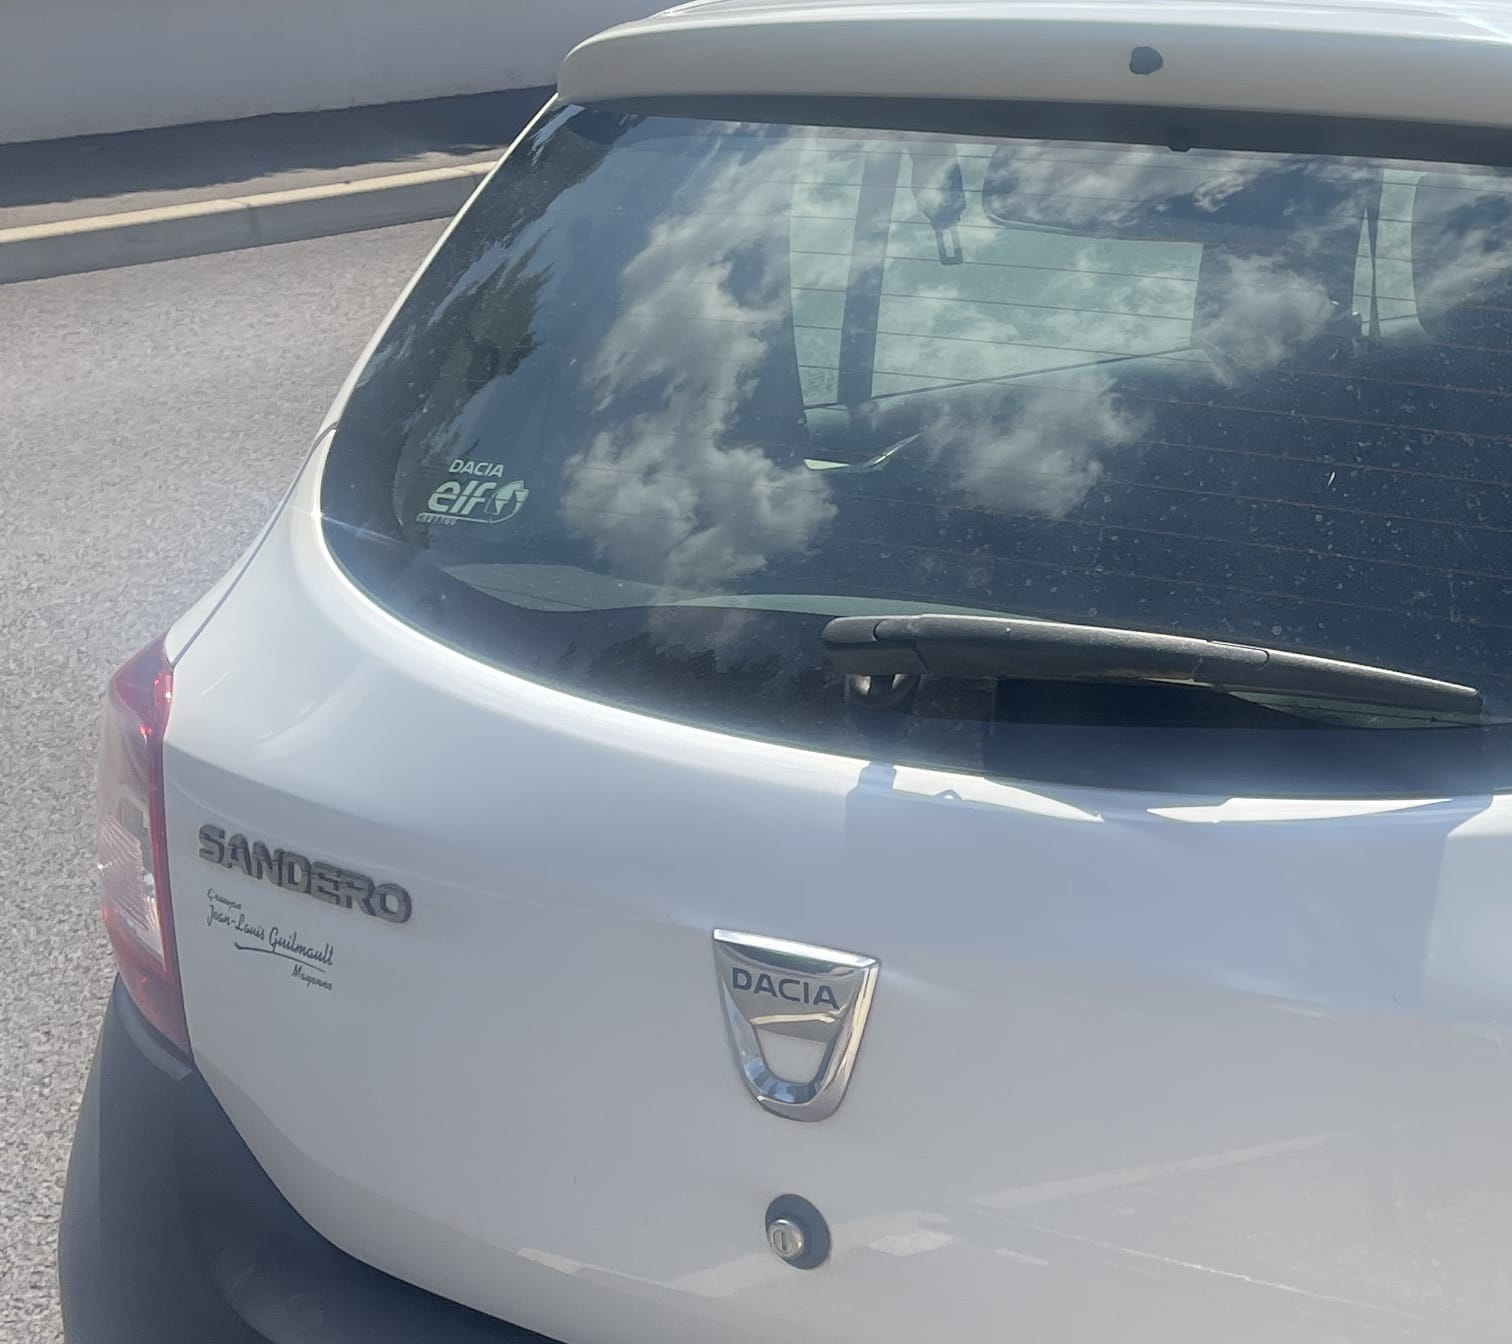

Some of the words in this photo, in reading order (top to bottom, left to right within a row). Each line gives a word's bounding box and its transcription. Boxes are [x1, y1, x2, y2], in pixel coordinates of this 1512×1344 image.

[448, 459, 505, 478] DACIA
[428, 479, 497, 515] elf
[198, 823, 413, 925] SANDERO
[207, 904, 265, 940] Jean-Louis
[269, 926, 334, 966] Guilmault
[732, 967, 840, 1010] DACIA
